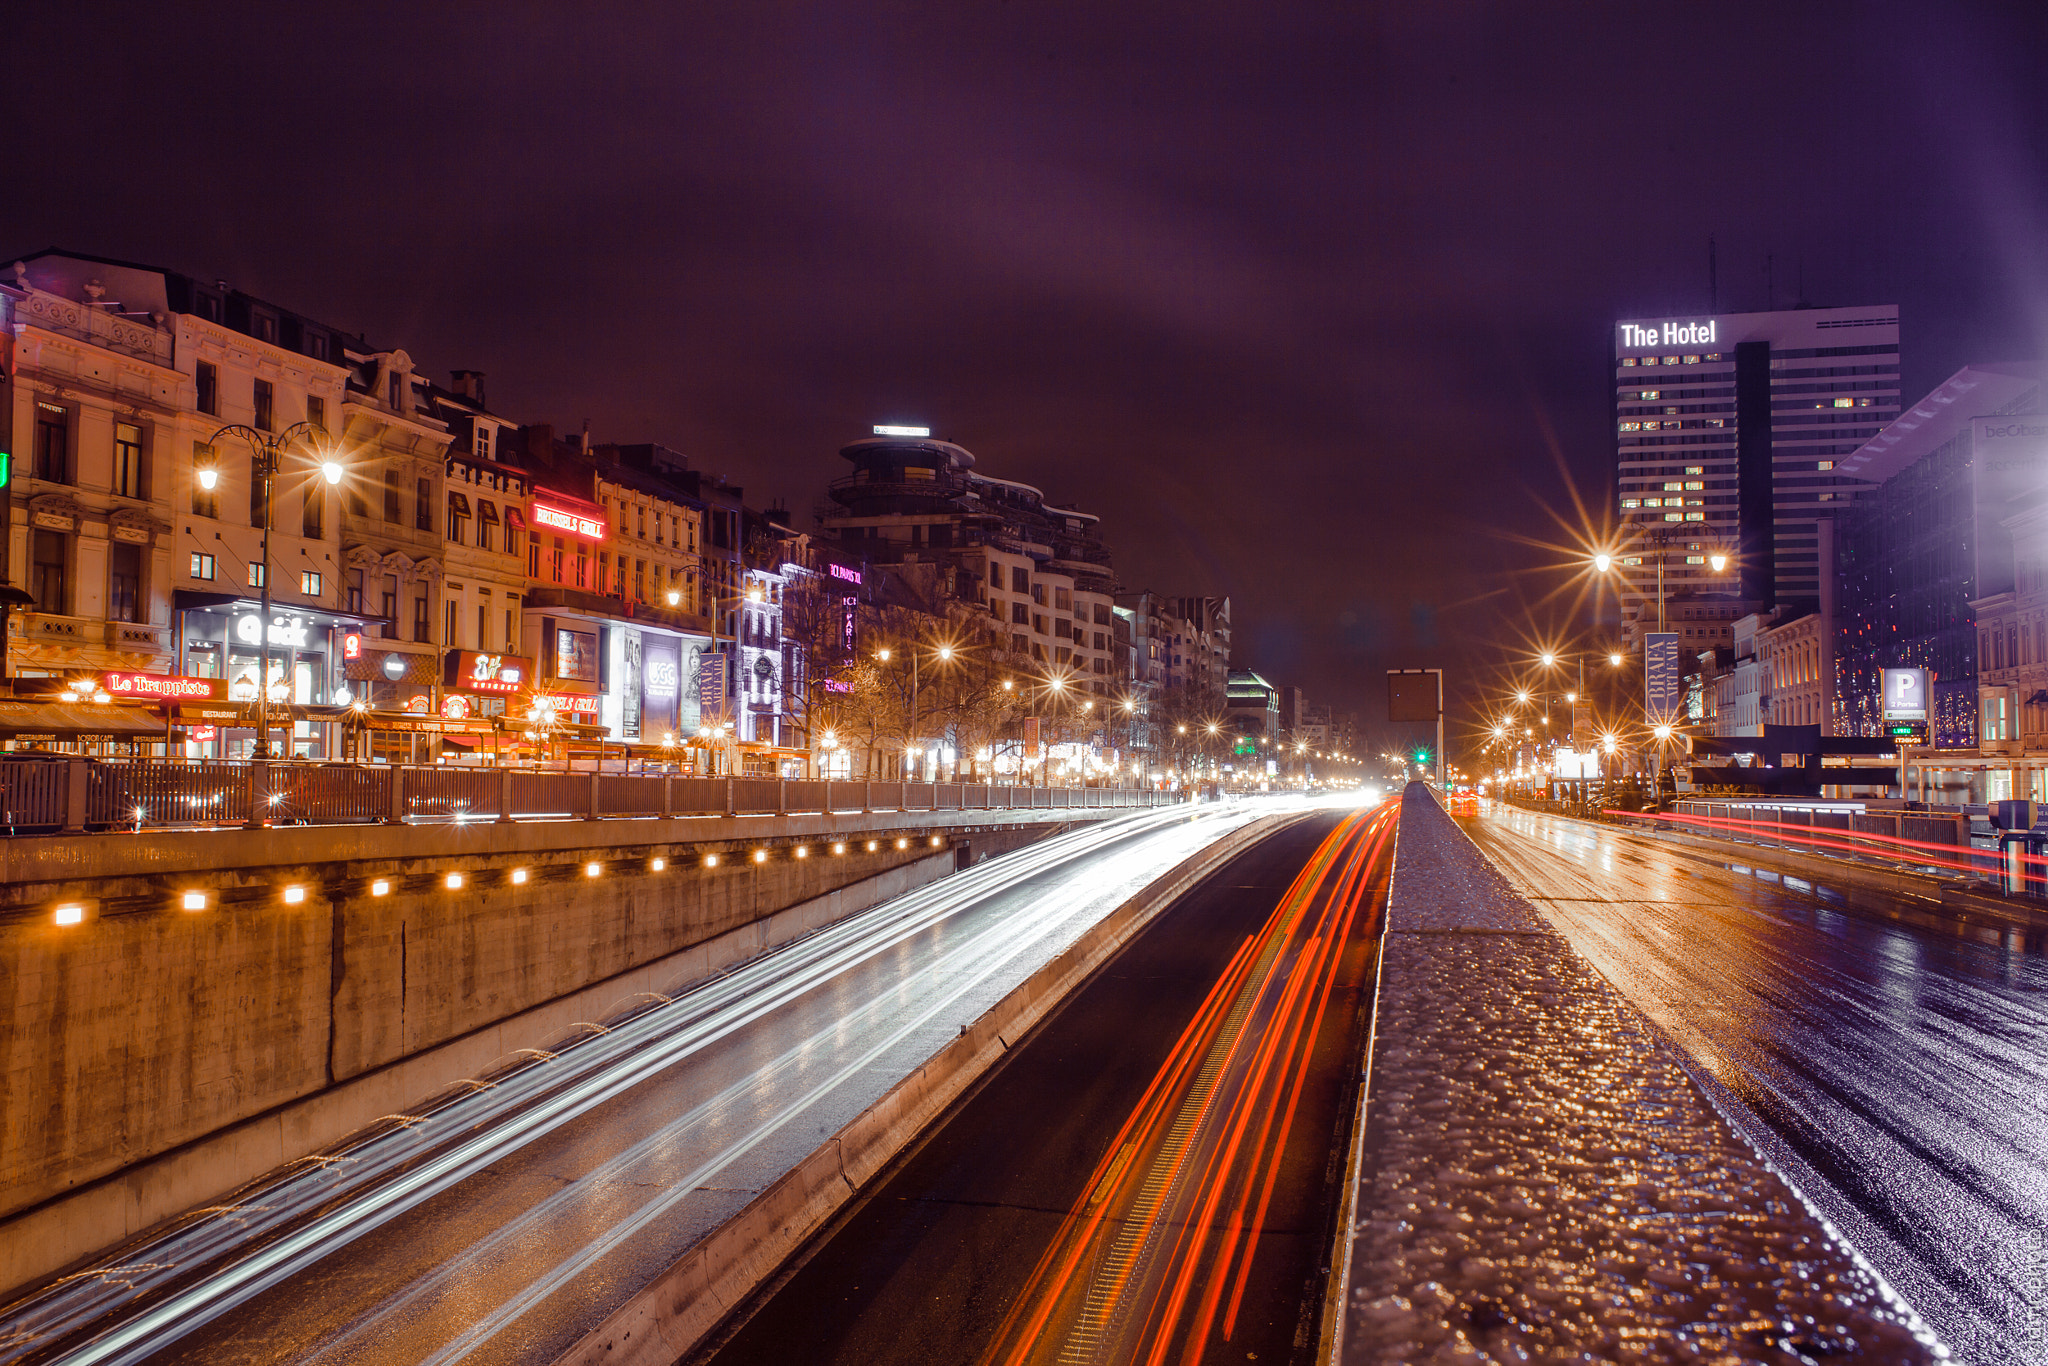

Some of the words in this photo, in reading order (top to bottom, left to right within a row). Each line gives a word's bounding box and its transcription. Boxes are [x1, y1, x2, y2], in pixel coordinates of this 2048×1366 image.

[1621, 324, 1659, 347] The
[1663, 320, 1716, 345] Hotel
[536, 508, 577, 532] BRUSSELS
[579, 520, 603, 539] GRILL
[839, 566, 854, 583] PARIS
[843, 597, 856, 606] ICI
[845, 613, 853, 651] PARIS
[1666, 641, 1679, 670] FAIR
[649, 662, 675, 686] UGC
[713, 660, 722, 683] FAIR
[1648, 640, 1666, 699] BRAFA
[111, 675, 132, 691] Le
[134, 676, 210, 696] Trappiste
[701, 658, 713, 706] BRAFA
[1666, 673, 1679, 697] ART
[1896, 674, 1916, 698] P
[574, 698, 599, 712] GRILL
[713, 685, 722, 704] ART
[202, 711, 237, 719] RESTAURANT
[307, 714, 337, 722] RESTAURANT
